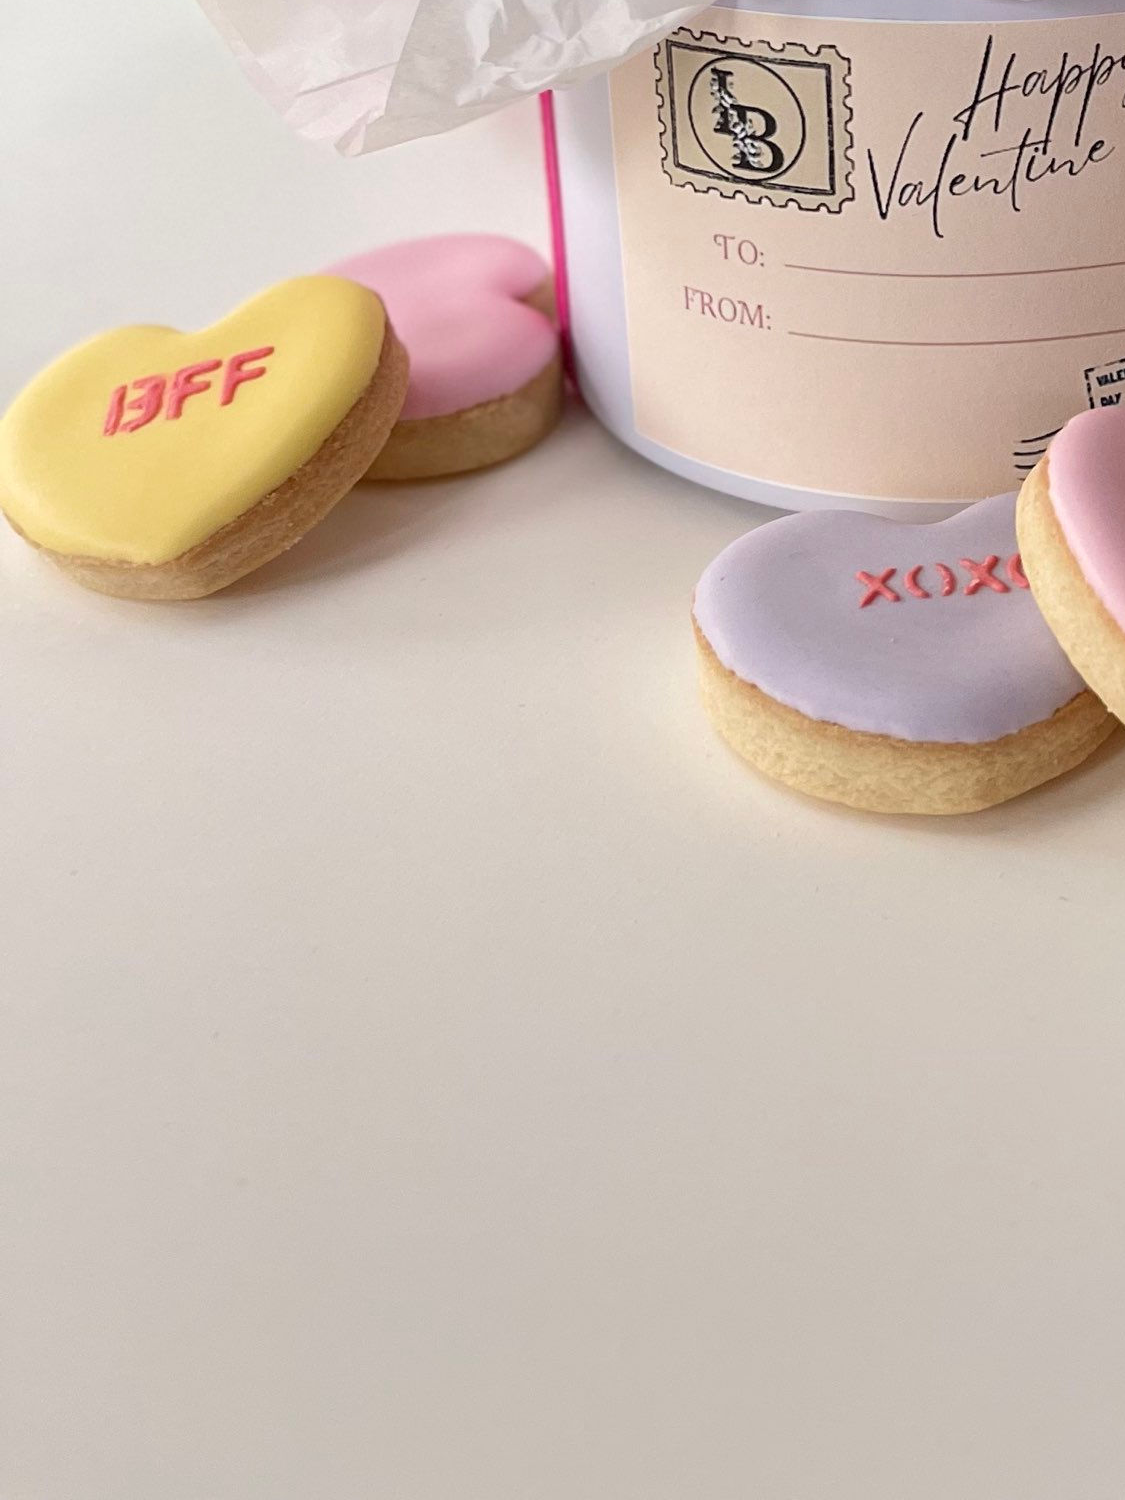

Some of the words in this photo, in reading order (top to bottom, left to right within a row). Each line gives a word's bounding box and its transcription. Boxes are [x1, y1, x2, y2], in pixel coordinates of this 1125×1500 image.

[867, 112, 1115, 238] Valentine
[713, 233, 765, 267] TO:
[683, 285, 772, 330] FROM:
[103, 346, 275, 437] BFF
[1100, 392, 1122, 407] DAY
